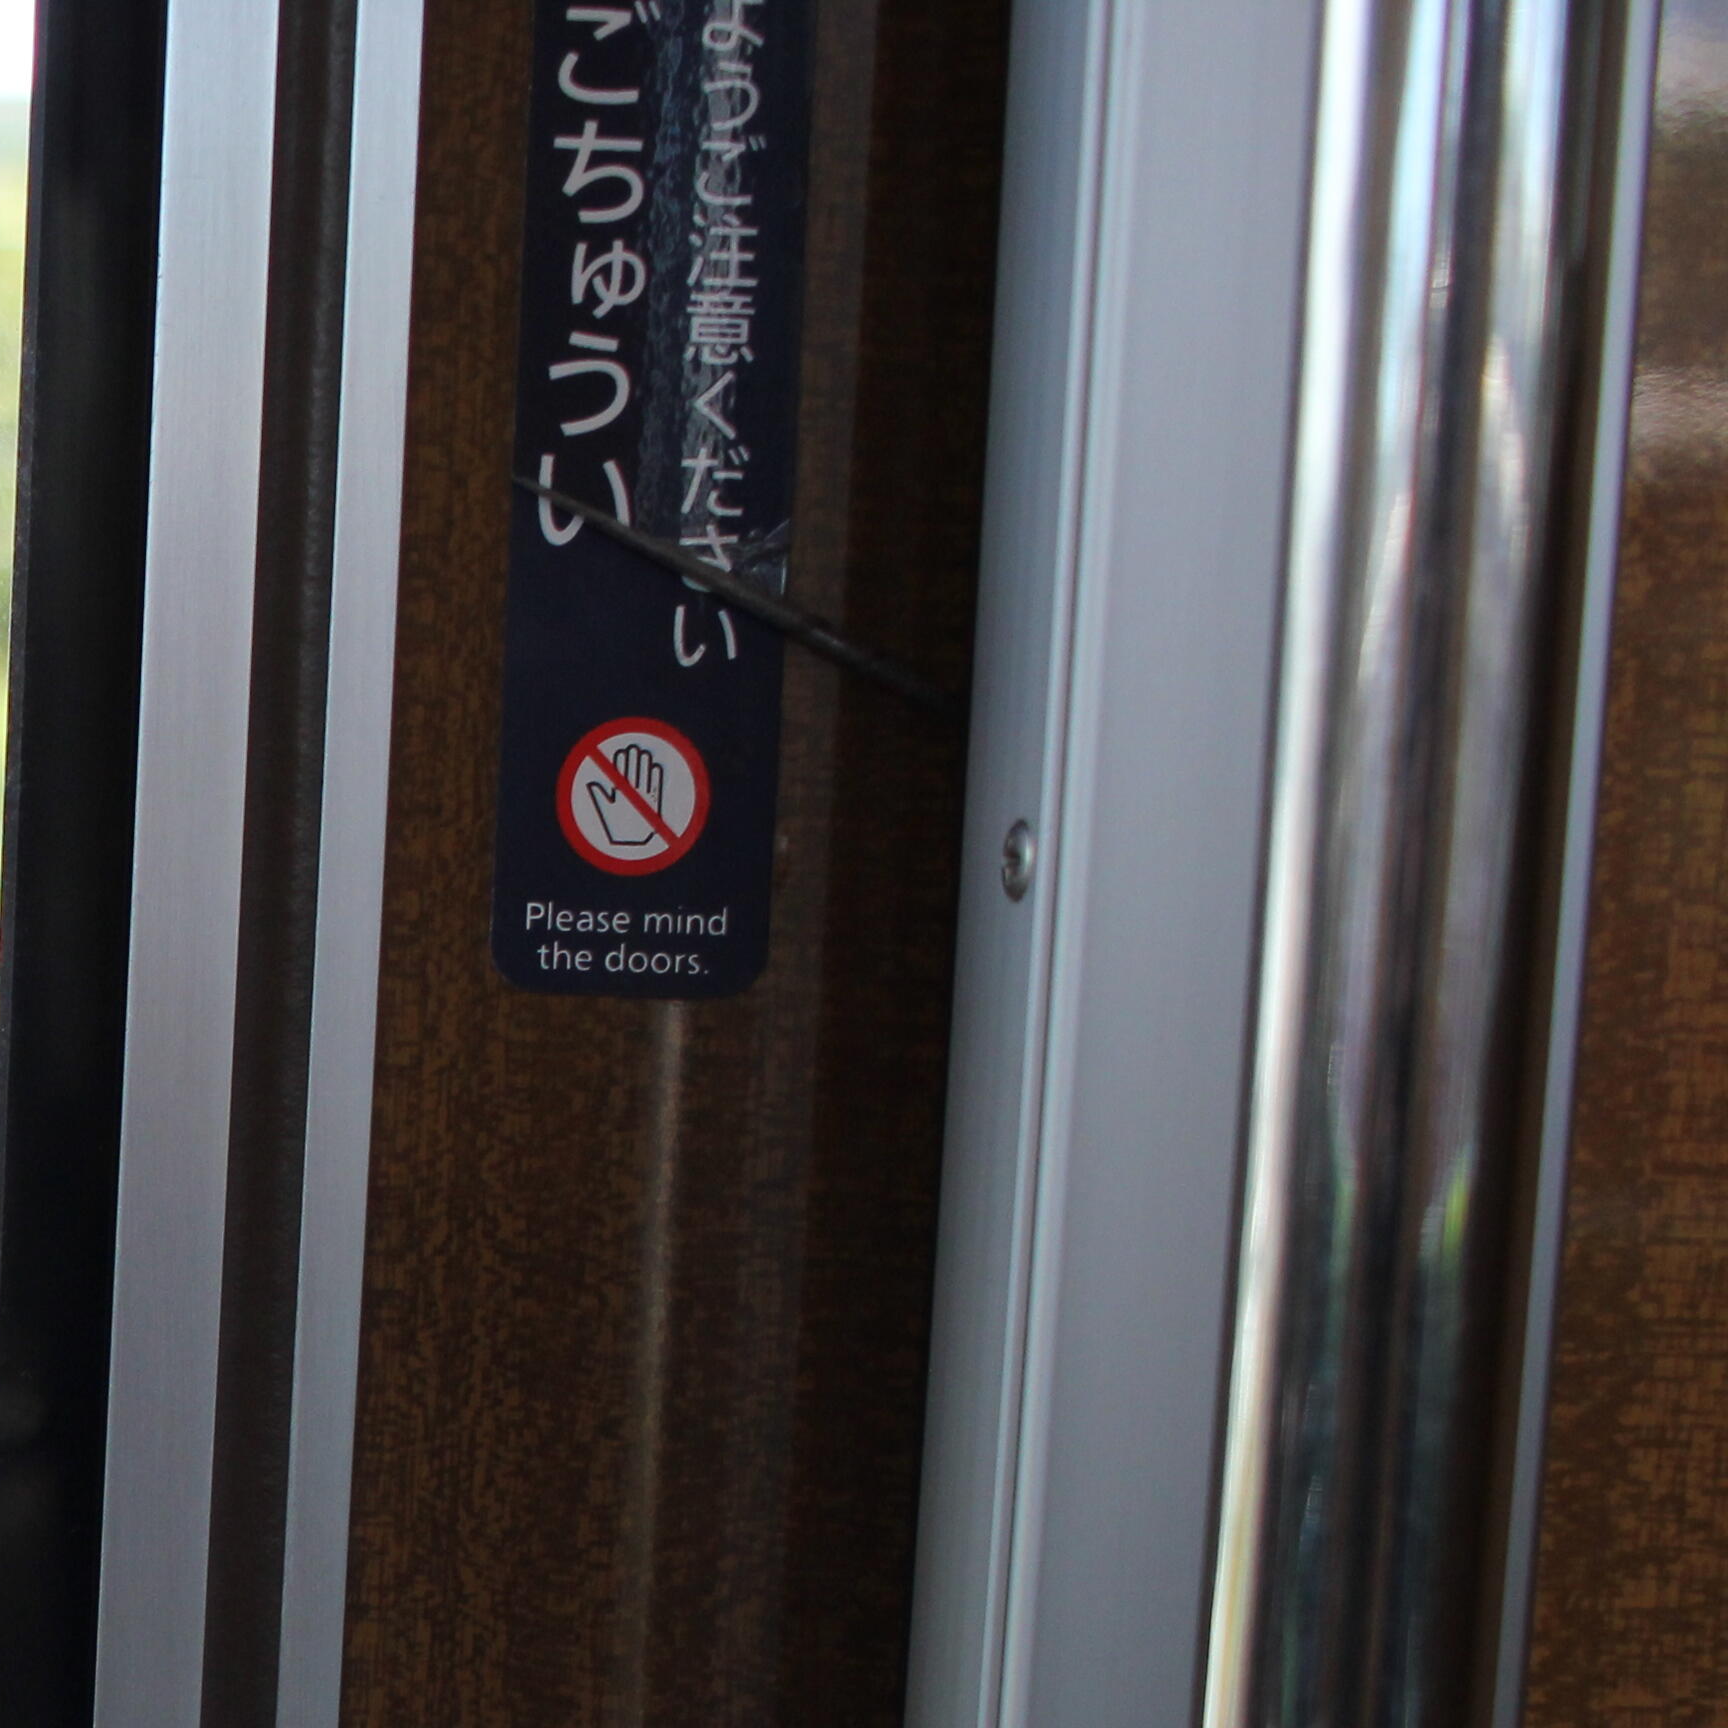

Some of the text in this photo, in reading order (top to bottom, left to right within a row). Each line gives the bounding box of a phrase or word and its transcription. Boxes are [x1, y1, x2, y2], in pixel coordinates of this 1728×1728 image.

[538, 1, 661, 547] ごちゅうい
[525, 901, 728, 936] Please mind
[537, 941, 710, 975] the doors.
